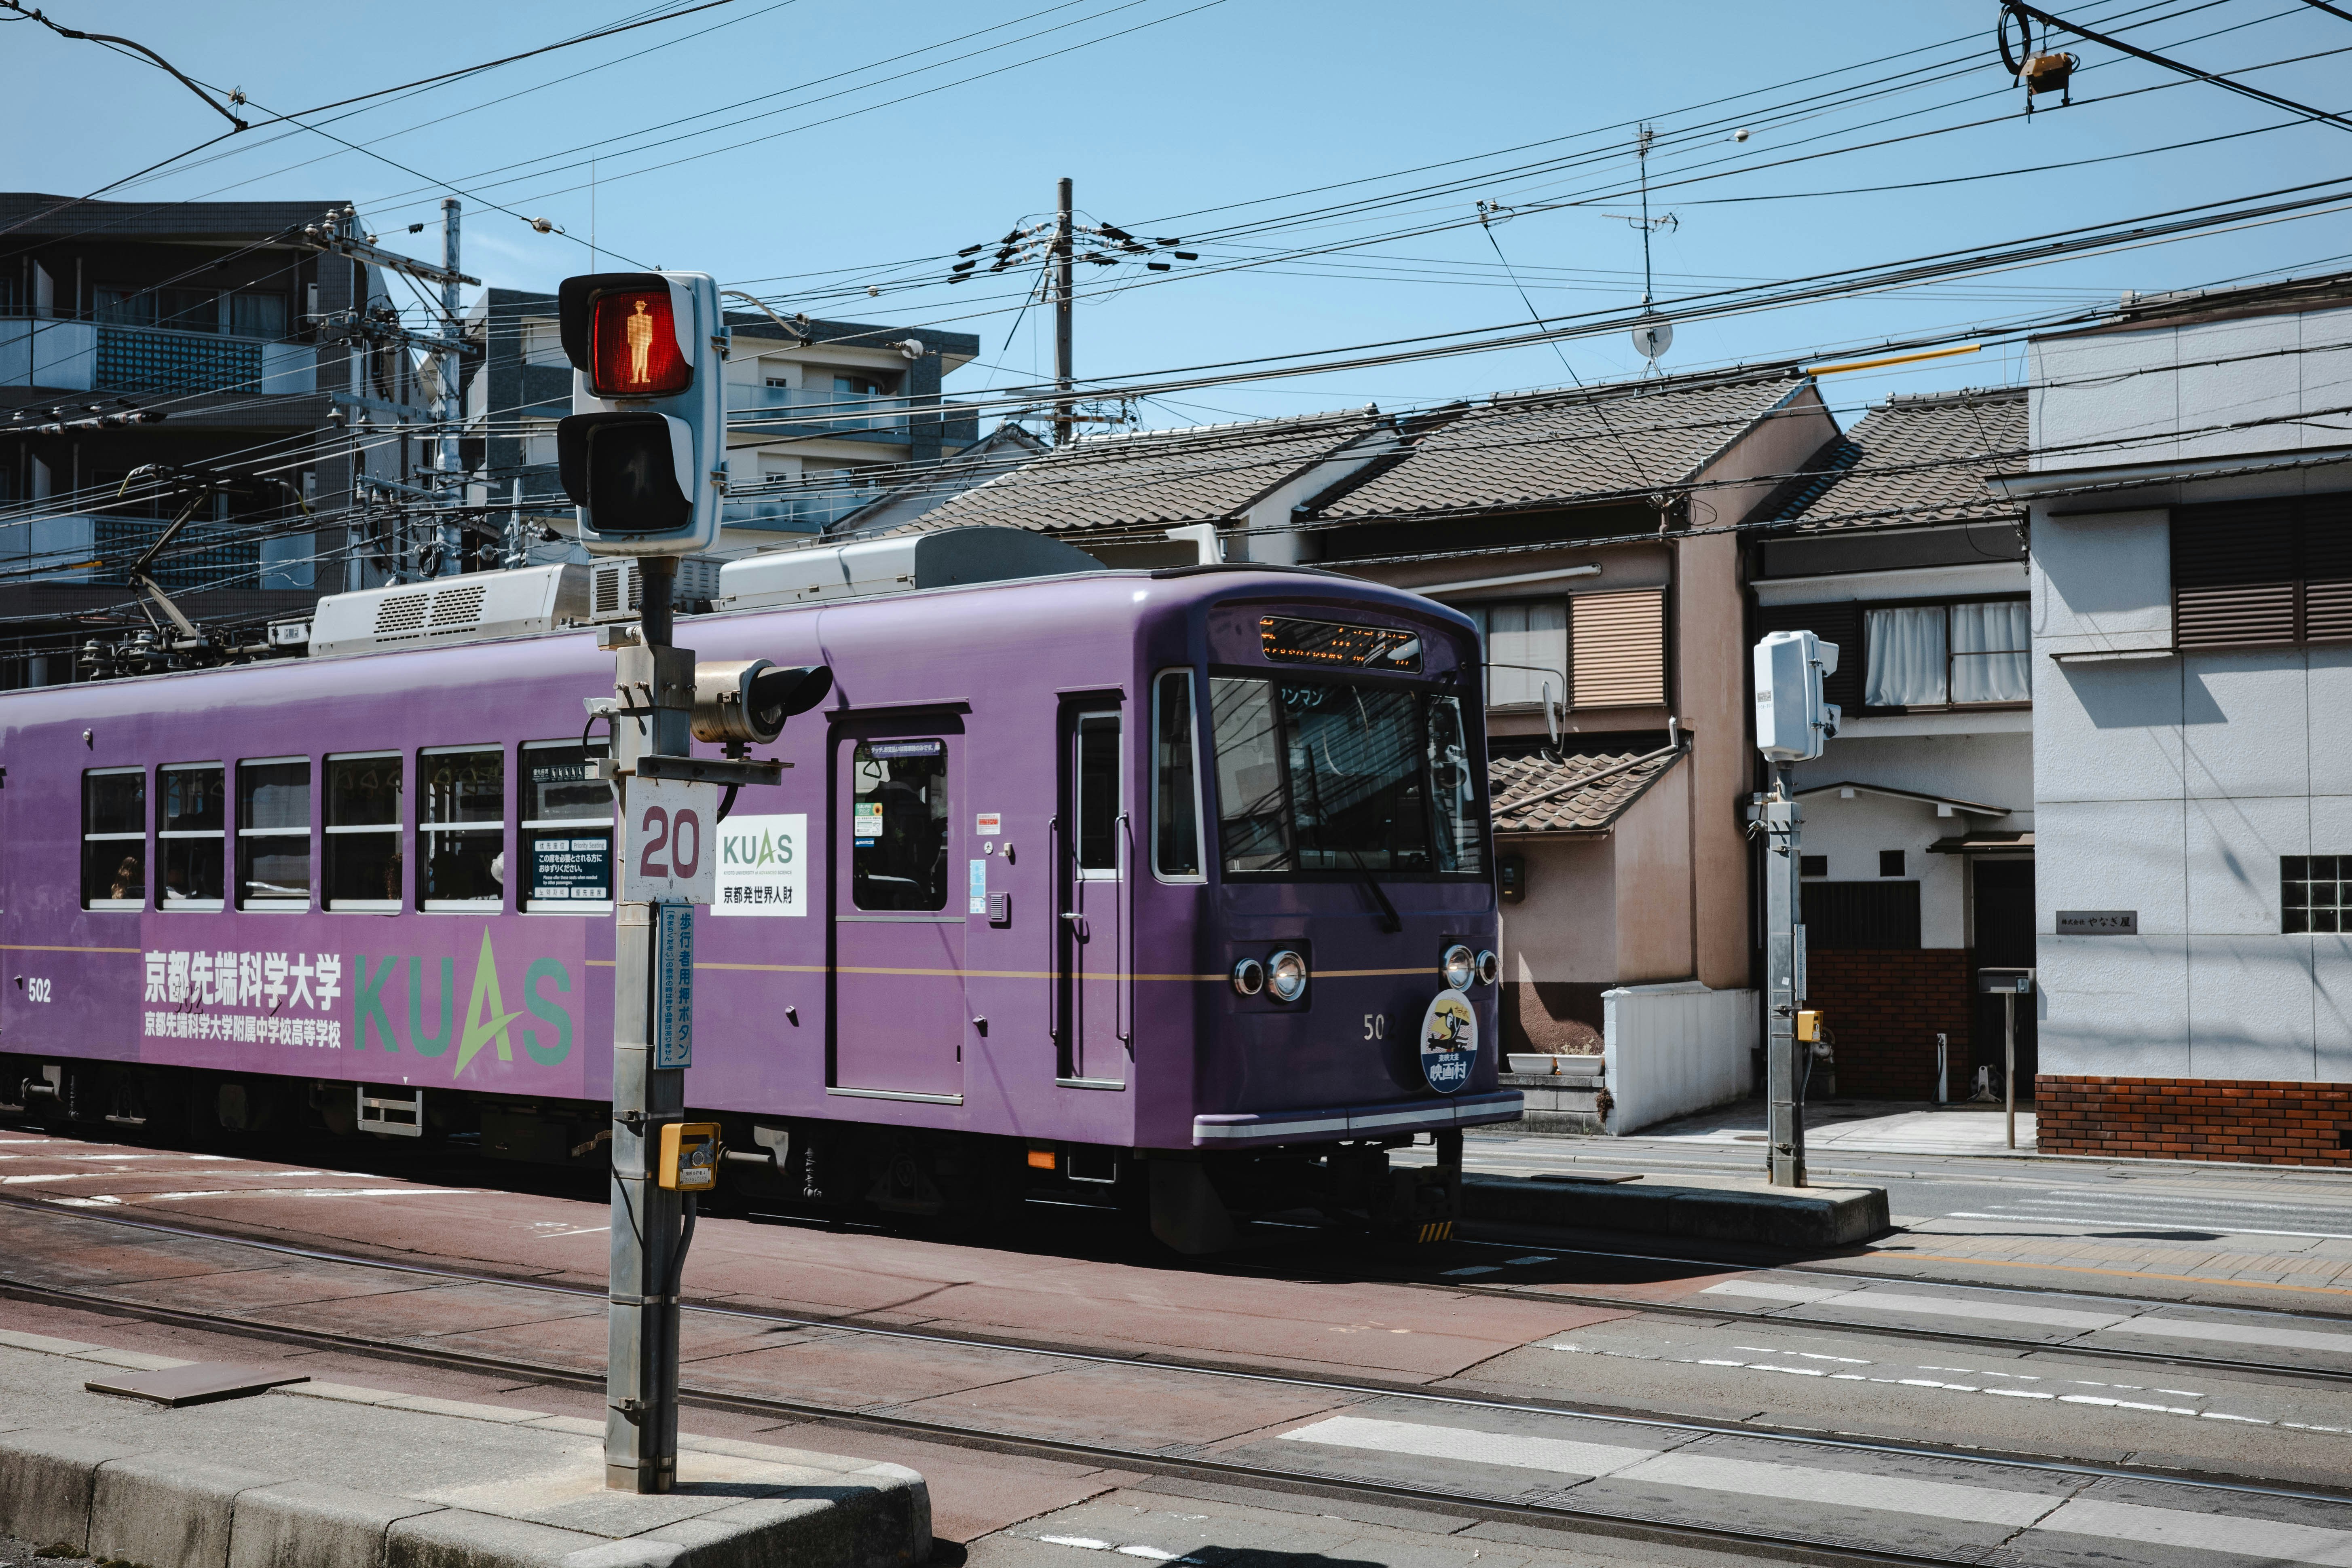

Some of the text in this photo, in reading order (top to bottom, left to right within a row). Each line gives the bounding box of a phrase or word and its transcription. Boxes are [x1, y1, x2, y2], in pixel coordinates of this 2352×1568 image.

[539, 854, 602, 863] この席を必要とされる方に
[640, 806, 699, 879] 20
[724, 827, 792, 869] KUAS
[539, 864, 582, 873] おゆずりください。
[724, 886, 792, 904] 京都発世界人財
[2088, 916, 2131, 927] やなぎ屋
[29, 978, 51, 1003] 502
[145, 950, 341, 1011] 京都先端科学大学
[678, 912, 691, 1059] 歩行者用押ボタン
[354, 924, 573, 1081] KUAS
[145, 1010, 341, 1050] 京都先端科学大学附属中学校高等学校
[1430, 1061, 1467, 1082] 映画村
